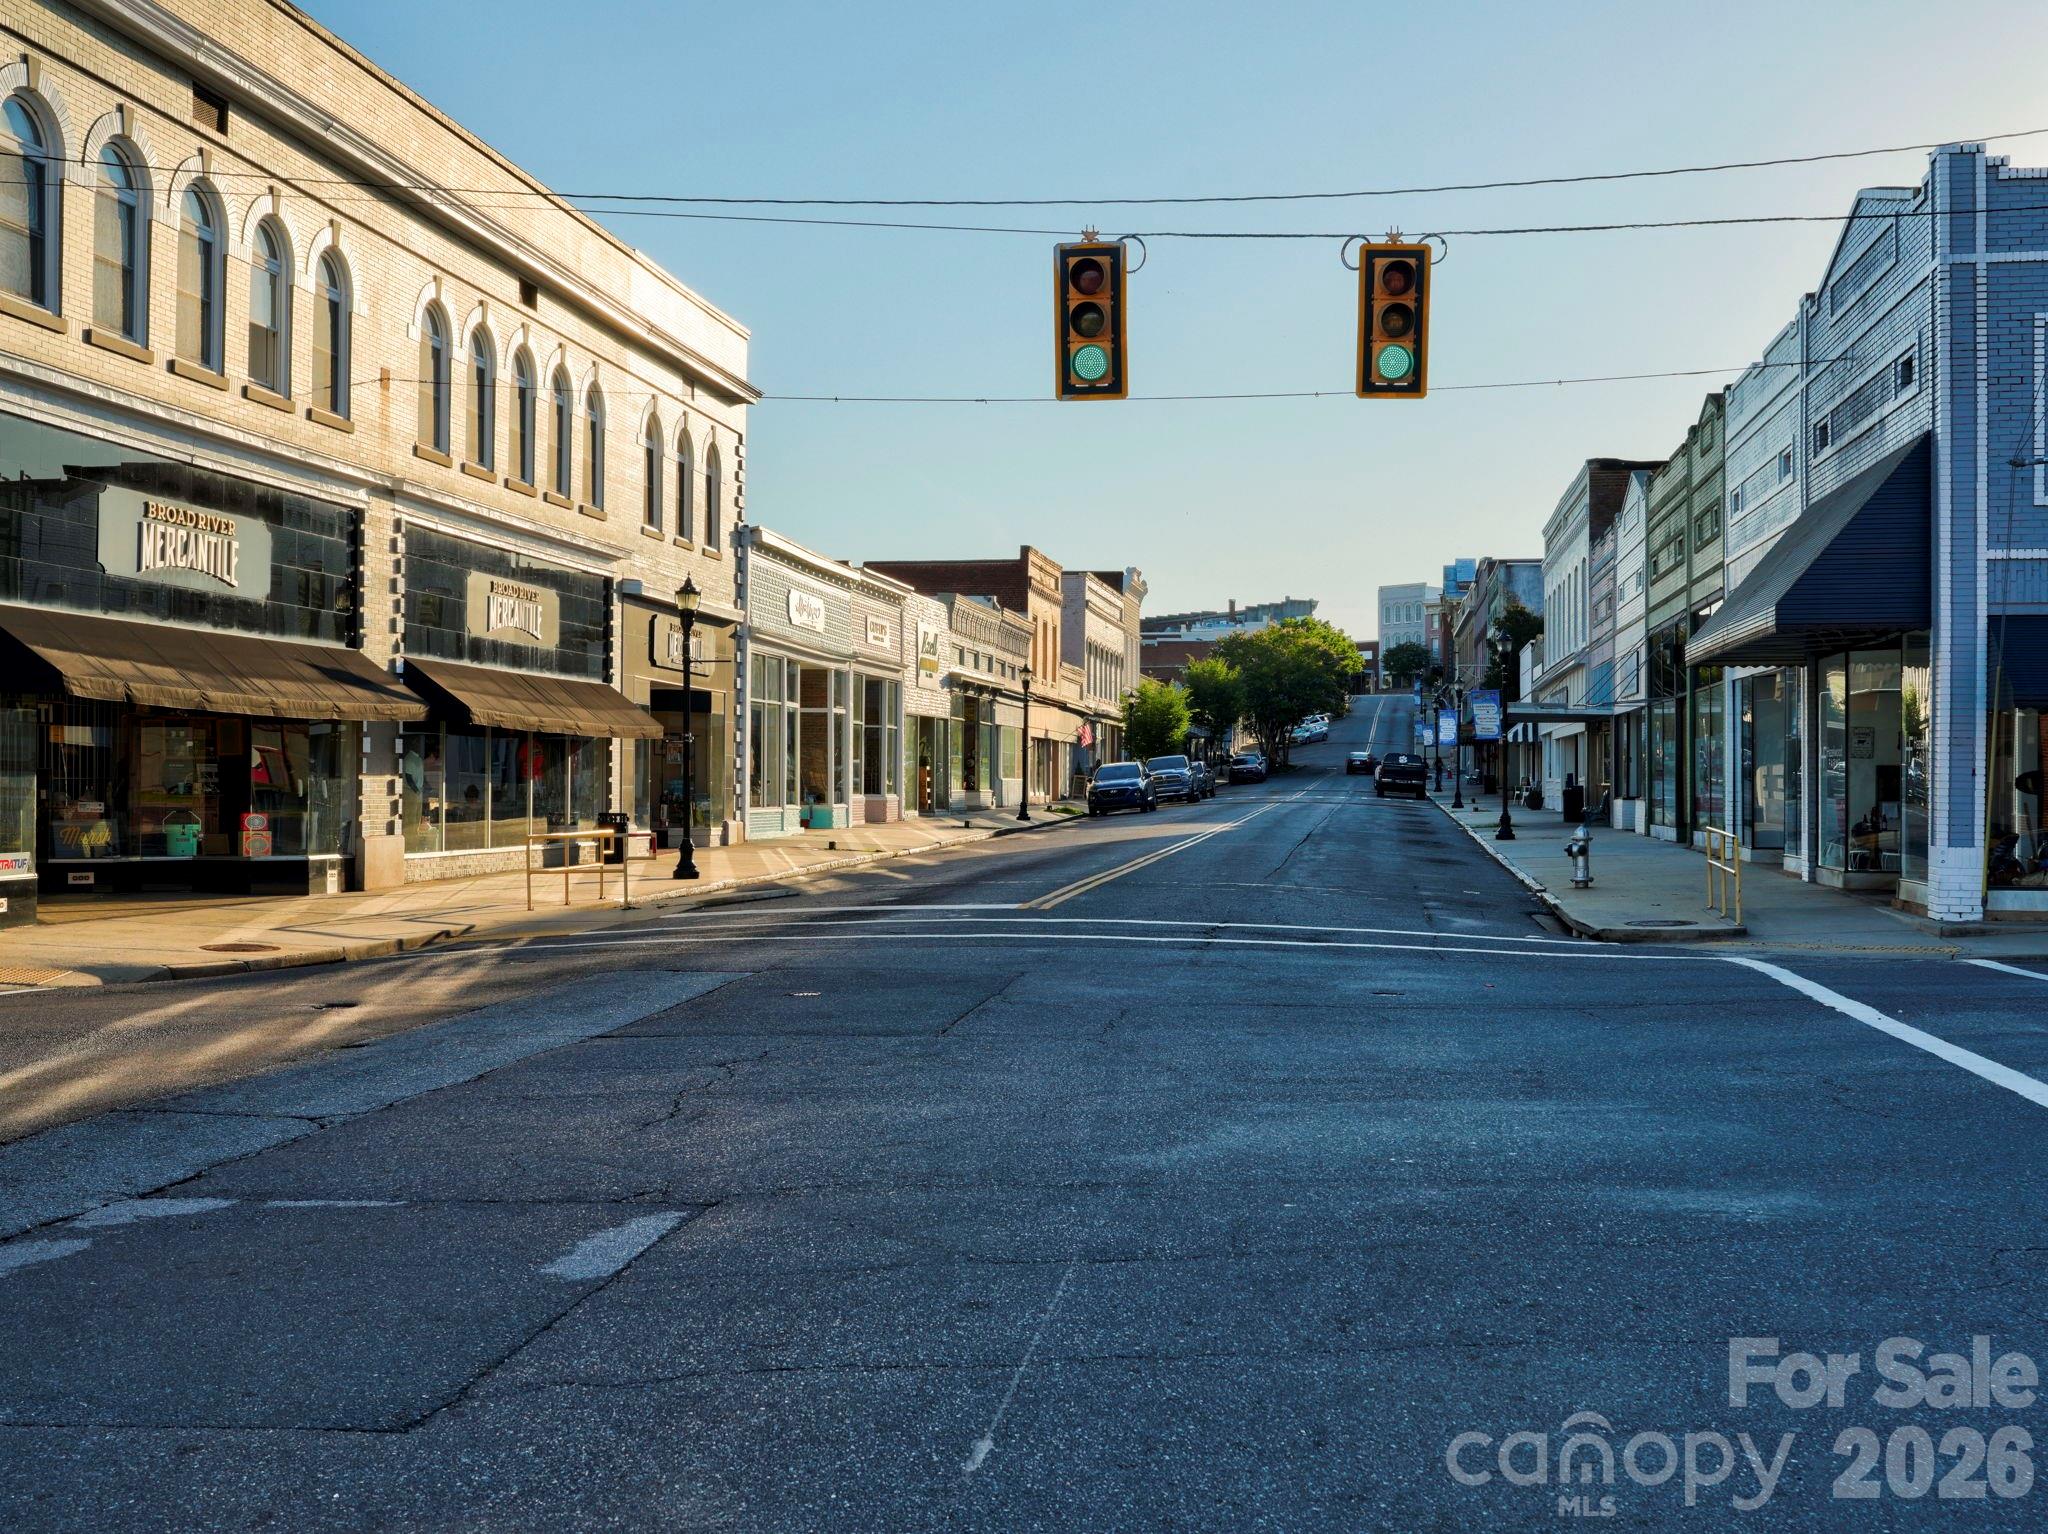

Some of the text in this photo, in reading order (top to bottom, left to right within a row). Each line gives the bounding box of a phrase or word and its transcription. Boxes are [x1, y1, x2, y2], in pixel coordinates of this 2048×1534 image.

[146, 501, 236, 536] BROAD RIVER
[140, 521, 240, 588] MERCANTILE
[491, 581, 519, 597] BROAD
[488, 595, 543, 640] MERCANTILE
[0, 858, 28, 870] TRATUF
